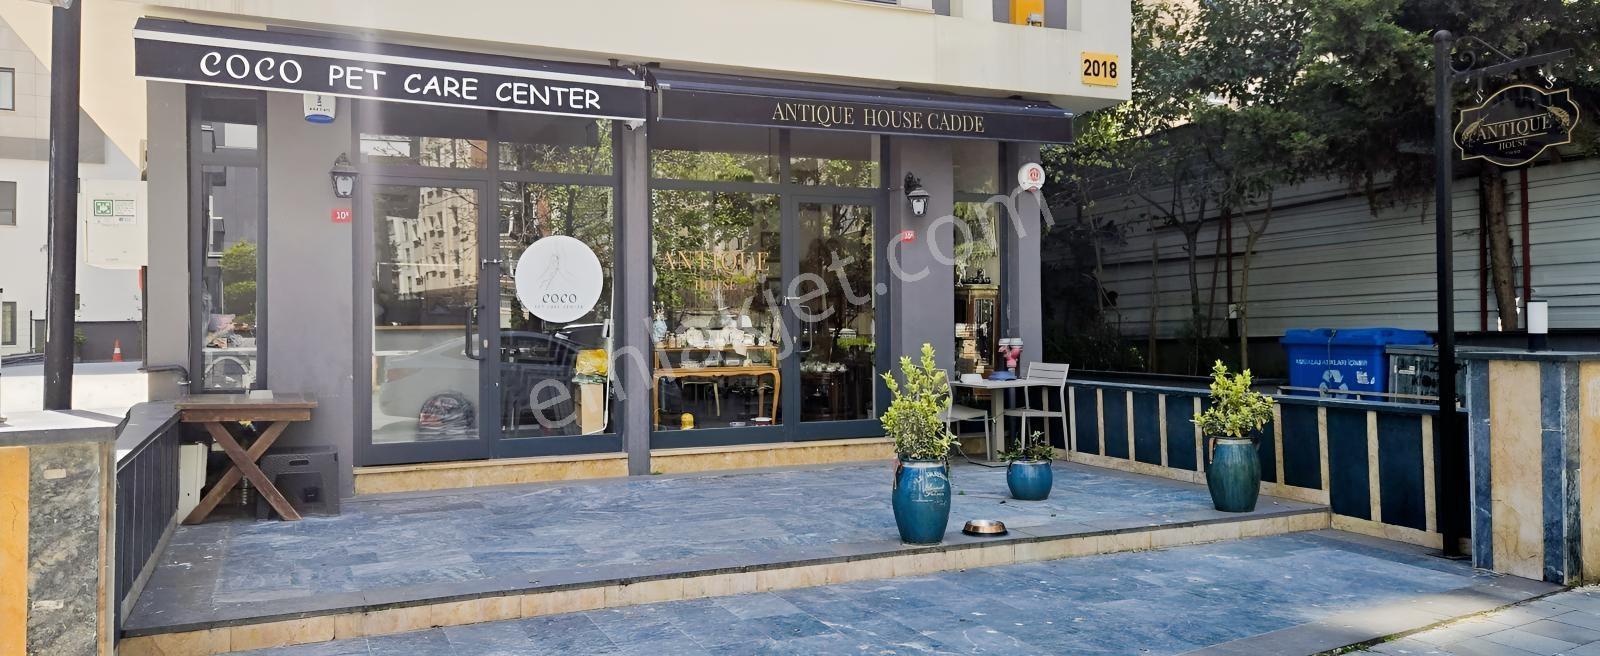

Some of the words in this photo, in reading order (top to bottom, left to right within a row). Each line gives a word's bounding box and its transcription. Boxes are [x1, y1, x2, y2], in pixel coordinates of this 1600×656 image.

[200, 51, 303, 84] COCO
[328, 65, 387, 91] PET
[403, 73, 479, 100] CARE
[495, 82, 601, 110] CENTER
[1083, 58, 1117, 78] 2018
[772, 102, 854, 127] ANTIQUE
[863, 108, 923, 129] HOUSE
[927, 112, 985, 133] CADDE
[1477, 115, 1552, 140] ANTIQUE
[1499, 139, 1528, 151] HOUSE
[663, 250, 770, 277] ANTIQUE
